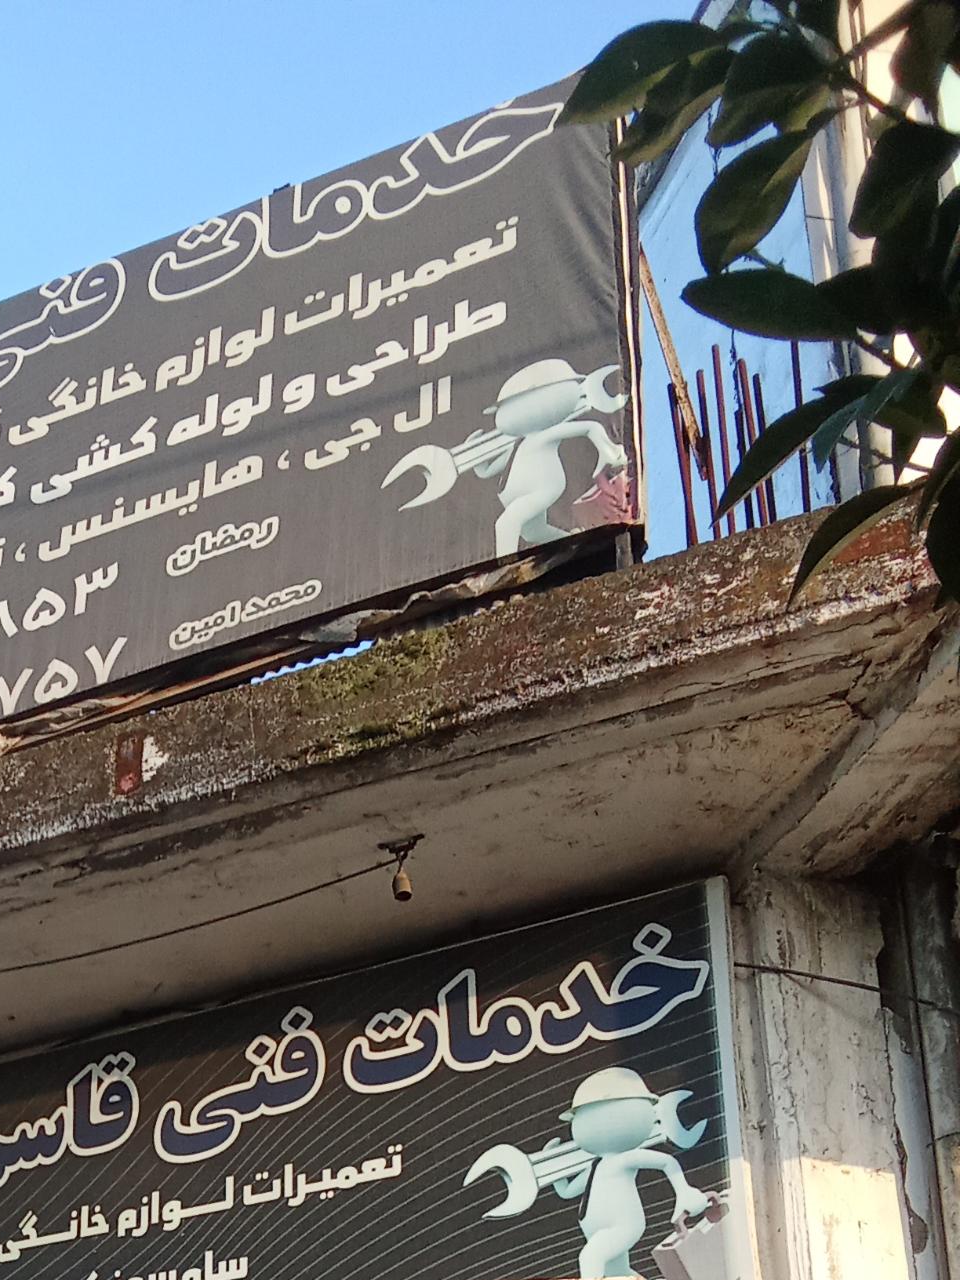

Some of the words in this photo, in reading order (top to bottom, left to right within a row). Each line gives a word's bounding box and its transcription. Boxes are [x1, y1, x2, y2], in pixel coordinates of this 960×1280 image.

[283, 215, 520, 335] تعمیرات
[154, 305, 275, 392] لوازم
[326, 299, 507, 397] طراحی
[8, 362, 146, 445] خانگی
[165, 374, 275, 447] لوله
[29, 416, 159, 502] کشی
[164, 514, 280, 578] رمضان
[342, 922, 710, 1094] خدمات
[153, 1006, 327, 1165] فنی
[116, 1175, 236, 1237] لوازم
[242, 1143, 404, 1207] تعمیرات
